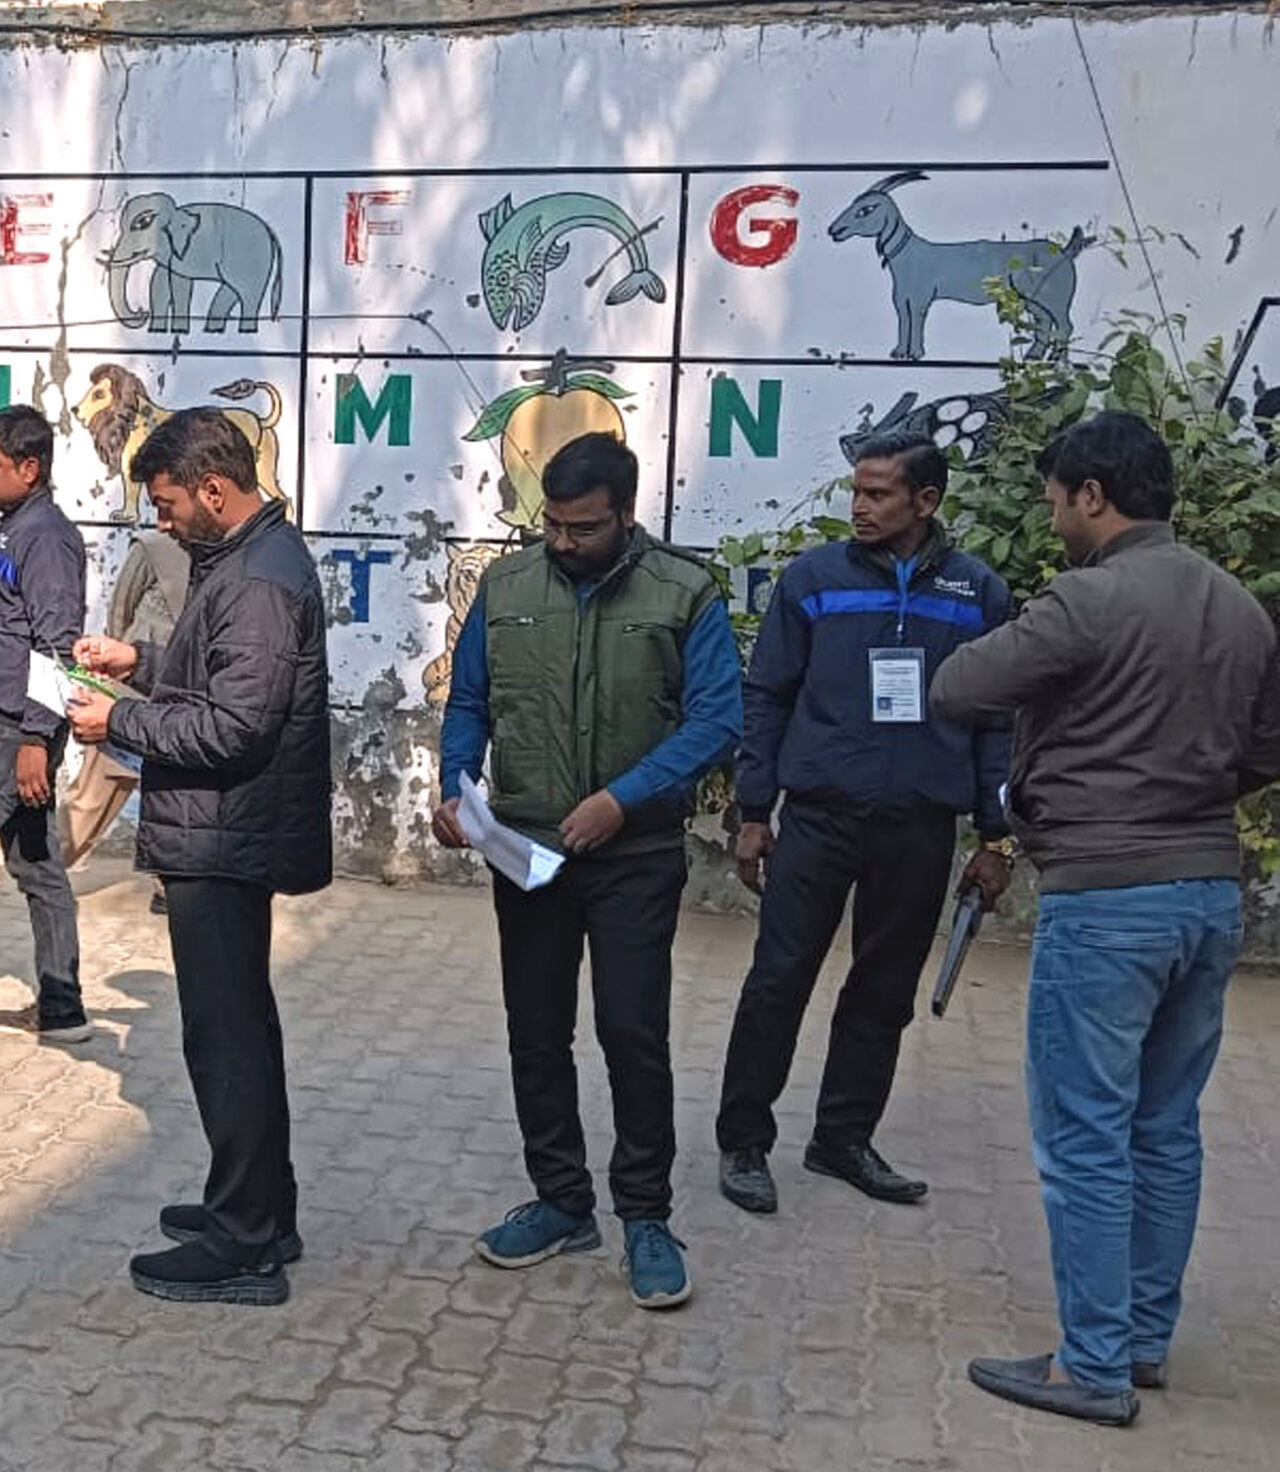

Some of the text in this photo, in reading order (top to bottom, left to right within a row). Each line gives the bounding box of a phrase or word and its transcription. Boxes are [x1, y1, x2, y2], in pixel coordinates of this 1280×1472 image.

[344, 190, 412, 265] F
[709, 184, 800, 269] G
[333, 373, 413, 447] M
[708, 378, 783, 459] N
[332, 549, 392, 623] T
